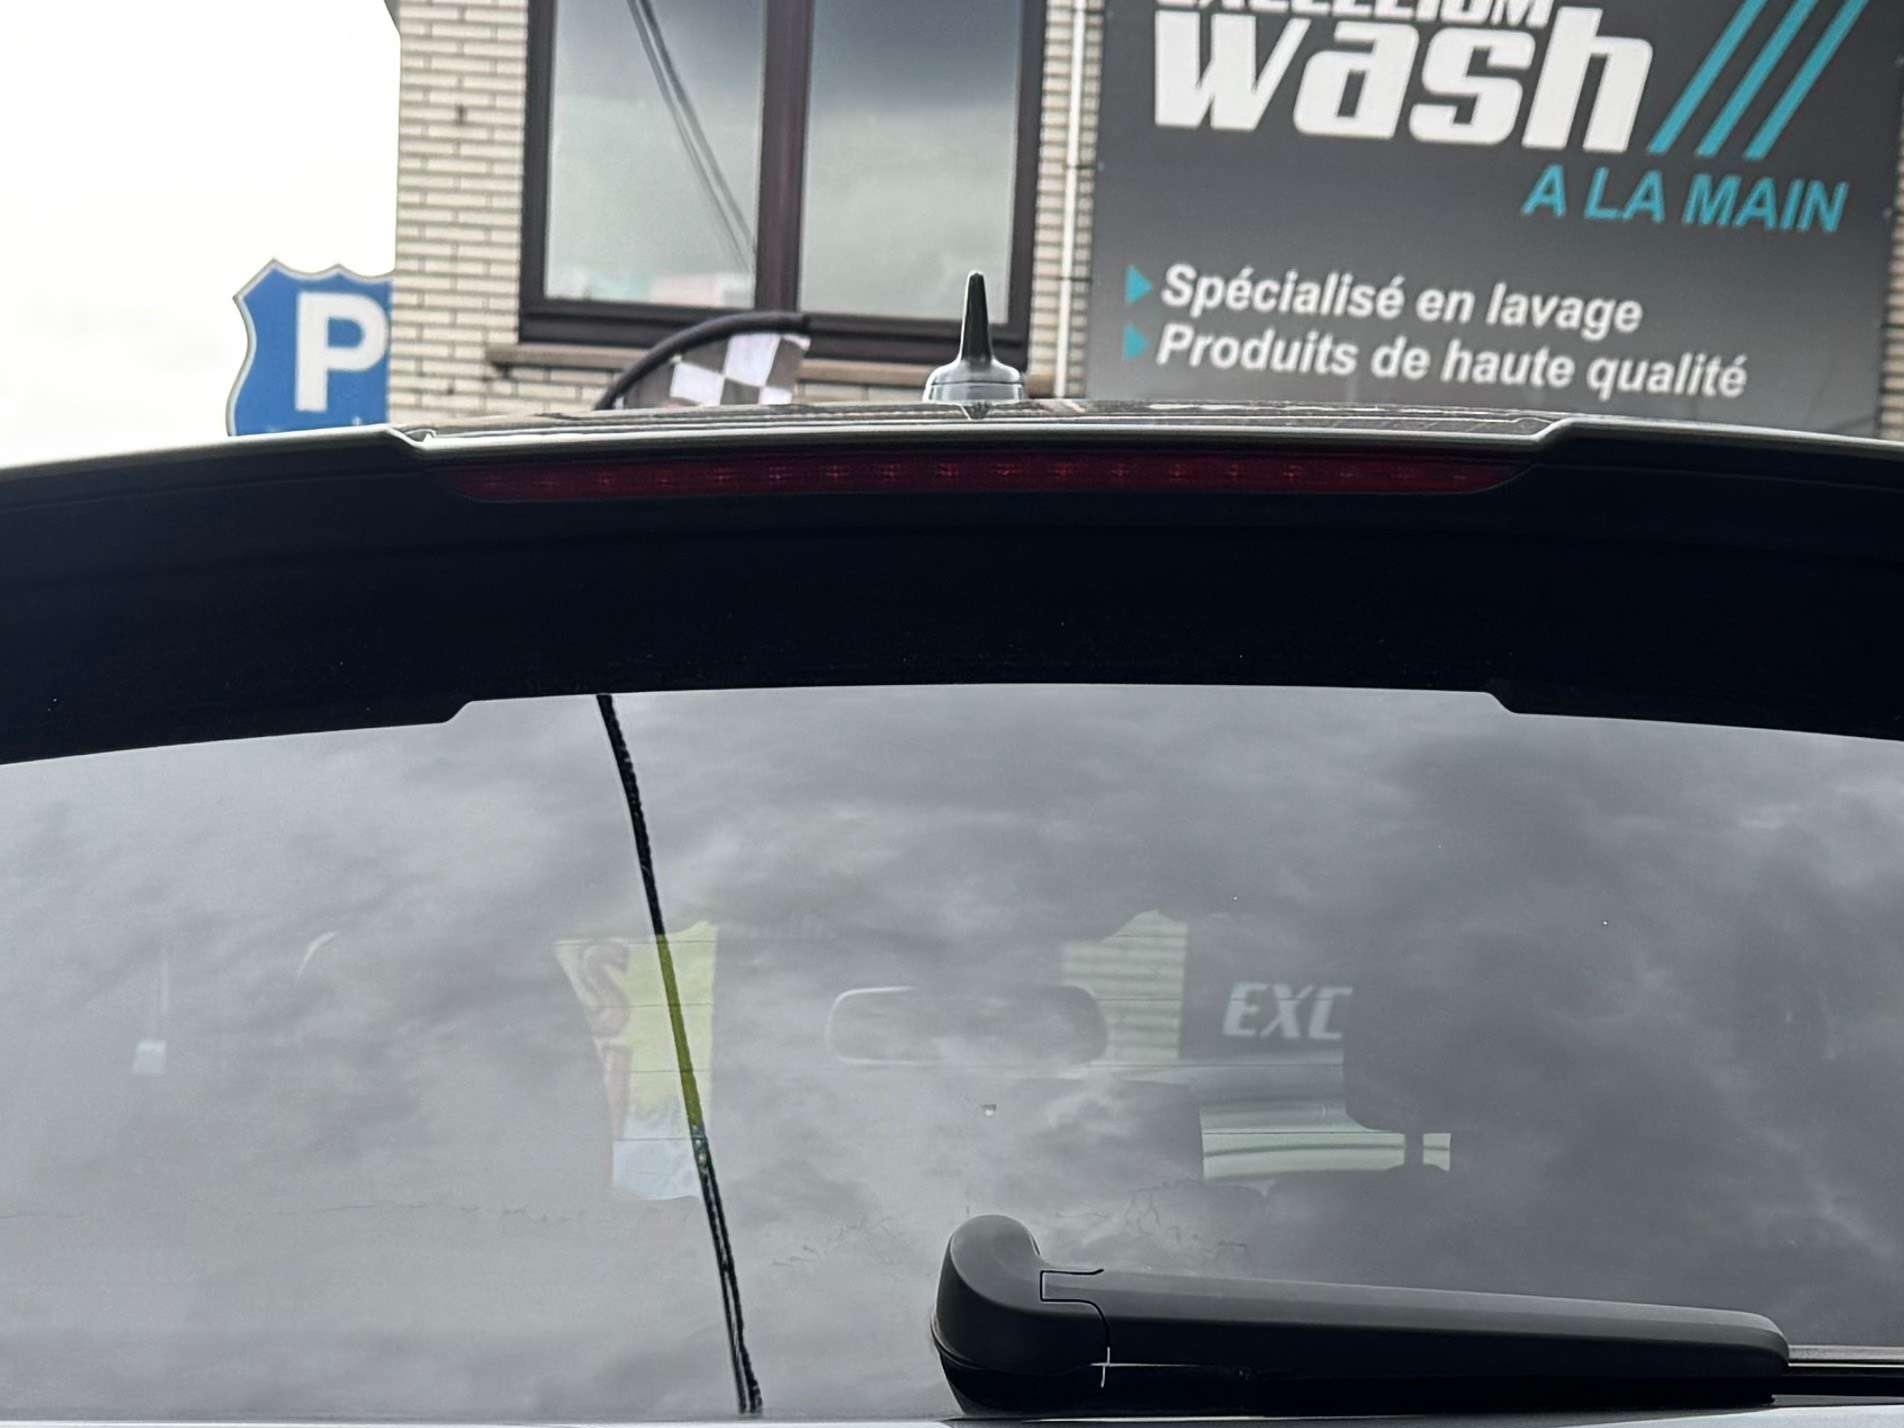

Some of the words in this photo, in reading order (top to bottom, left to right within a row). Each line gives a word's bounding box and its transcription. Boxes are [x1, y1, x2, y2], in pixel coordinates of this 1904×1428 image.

[1152, 7, 1654, 153] wash
[1521, 165, 1567, 217] A
[1584, 170, 1666, 226] LA
[1683, 174, 1850, 233] MAIN
[1160, 263, 1406, 321] Spécialisé
[1416, 286, 1475, 324] en
[1486, 284, 1644, 339] lavage
[295, 290, 389, 412] P
[1155, 324, 1358, 378] Produits
[1370, 335, 1430, 383] de
[1442, 342, 1576, 391] haute
[1586, 356, 1749, 400] qualité
